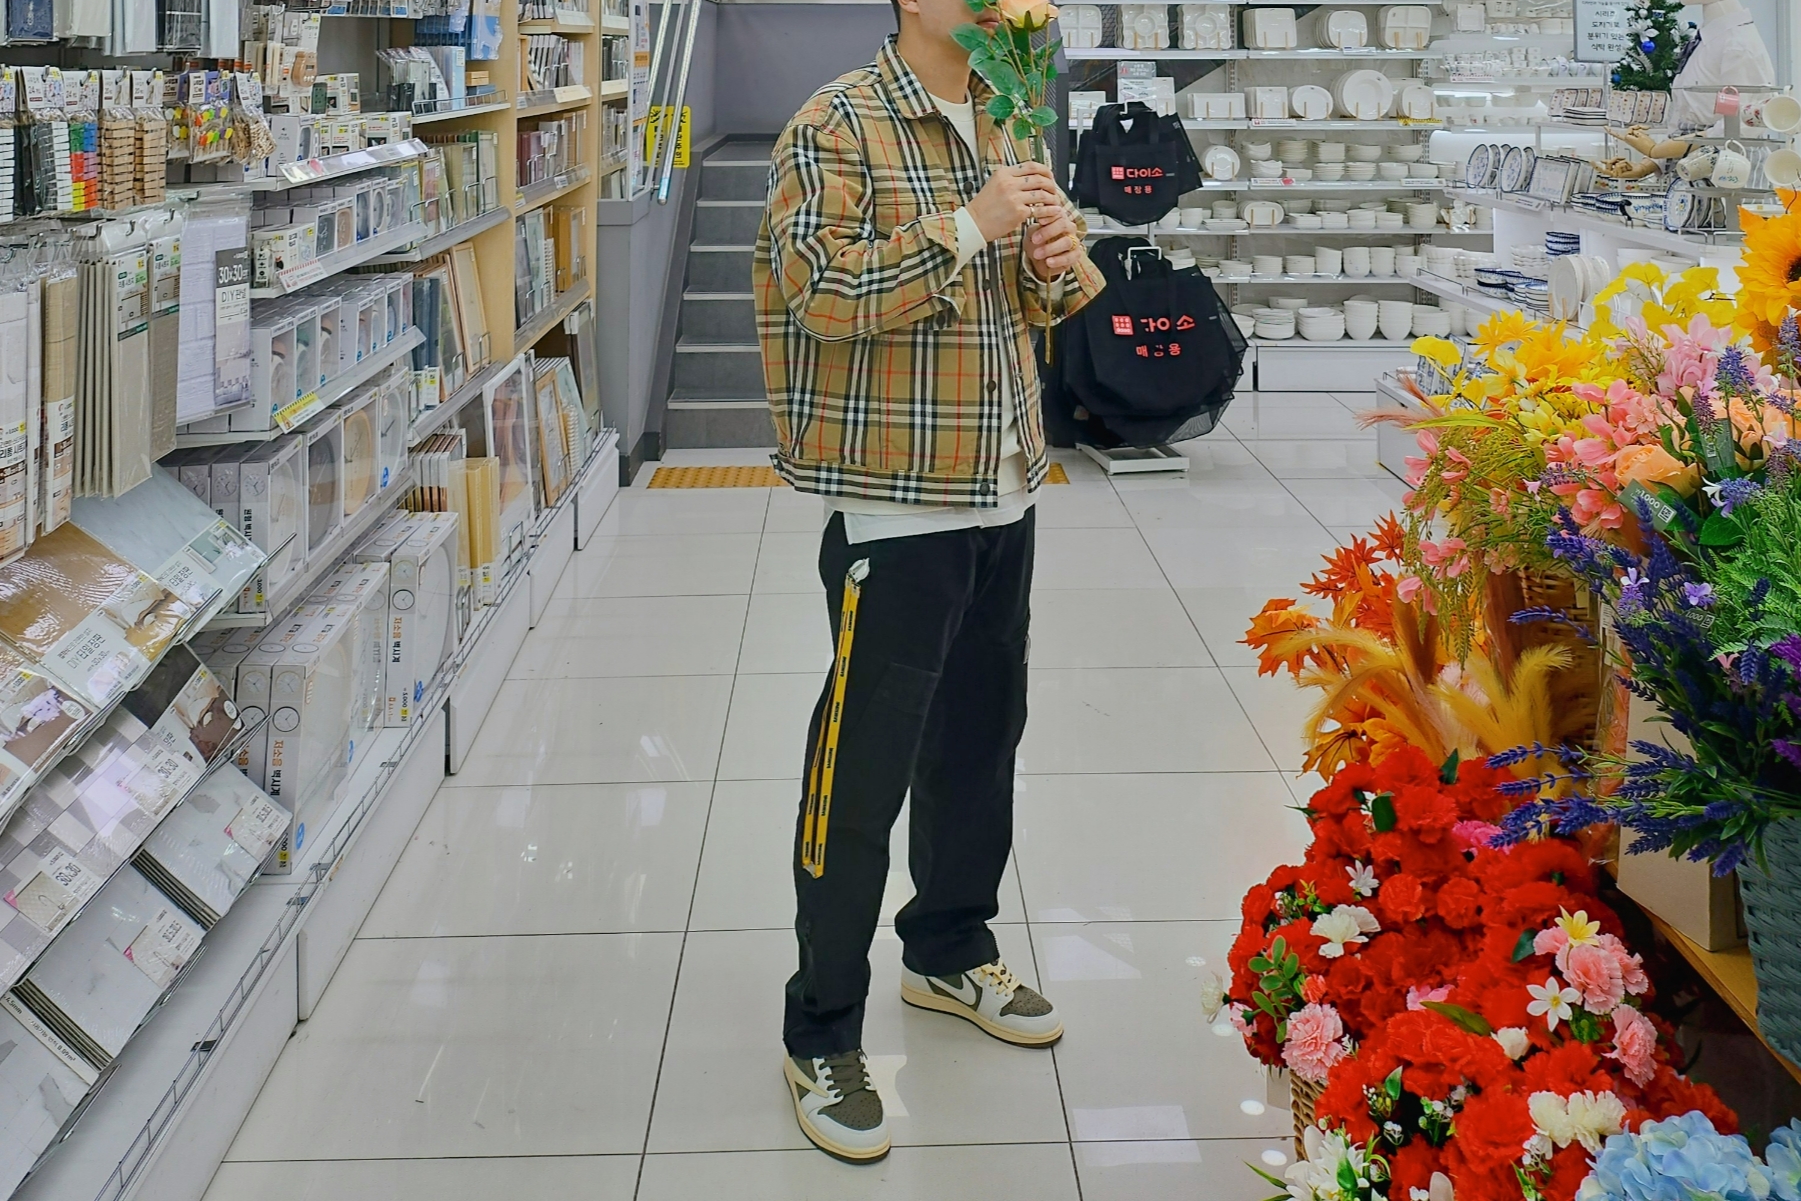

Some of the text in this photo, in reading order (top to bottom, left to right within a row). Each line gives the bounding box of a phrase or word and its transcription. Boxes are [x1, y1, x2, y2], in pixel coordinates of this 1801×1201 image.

[1126, 166, 1164, 179] 다이소
[1123, 185, 1153, 195] 매장용
[392, 641, 401, 663] 벽시계
[270, 740, 284, 796] 저소음 벽시계
